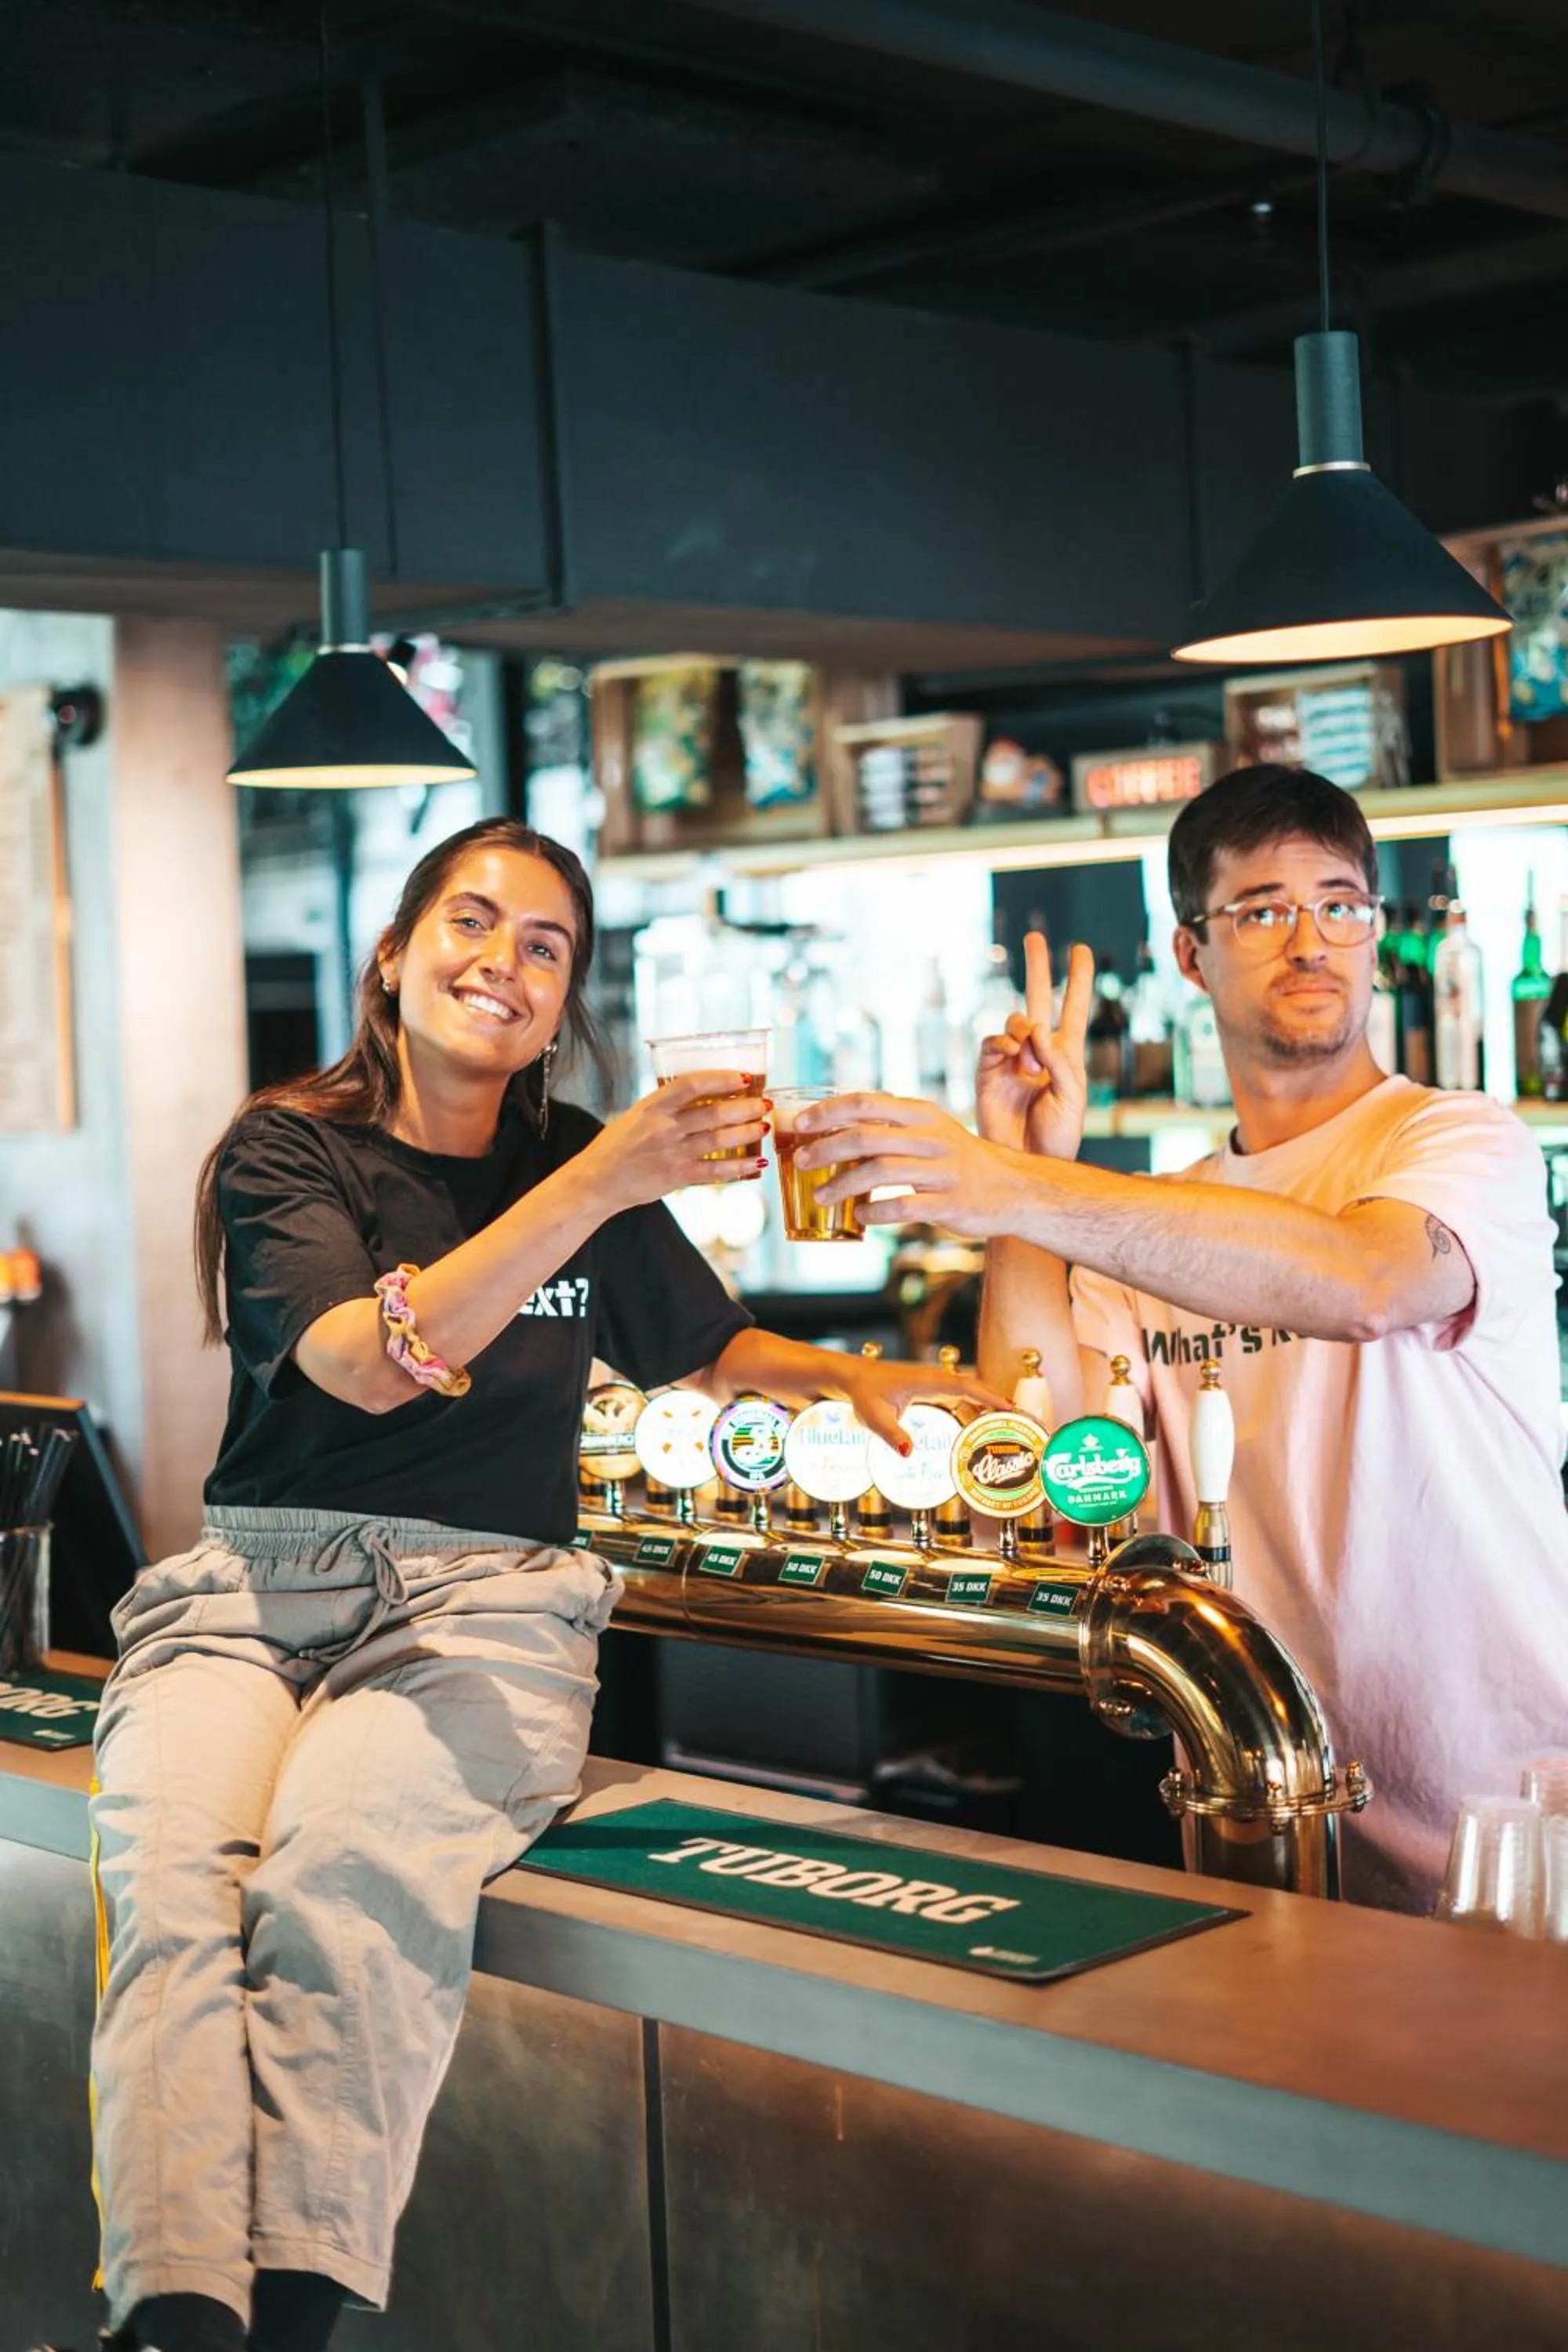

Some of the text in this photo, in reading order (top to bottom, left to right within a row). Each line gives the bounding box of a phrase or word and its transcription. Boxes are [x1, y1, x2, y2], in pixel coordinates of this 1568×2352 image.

[972, 1452, 1034, 1484] Classic
[1044, 1449, 1142, 1490] Carlsberg
[1067, 1490, 1127, 1504] DANMARK
[798, 1563, 817, 1573] DKK
[869, 1569, 902, 1584] 50 DKK
[952, 1581, 986, 1592] 35 DKK
[1036, 1592, 1073, 1606] 35 DKK
[648, 1837, 1022, 1924] TUBORG
